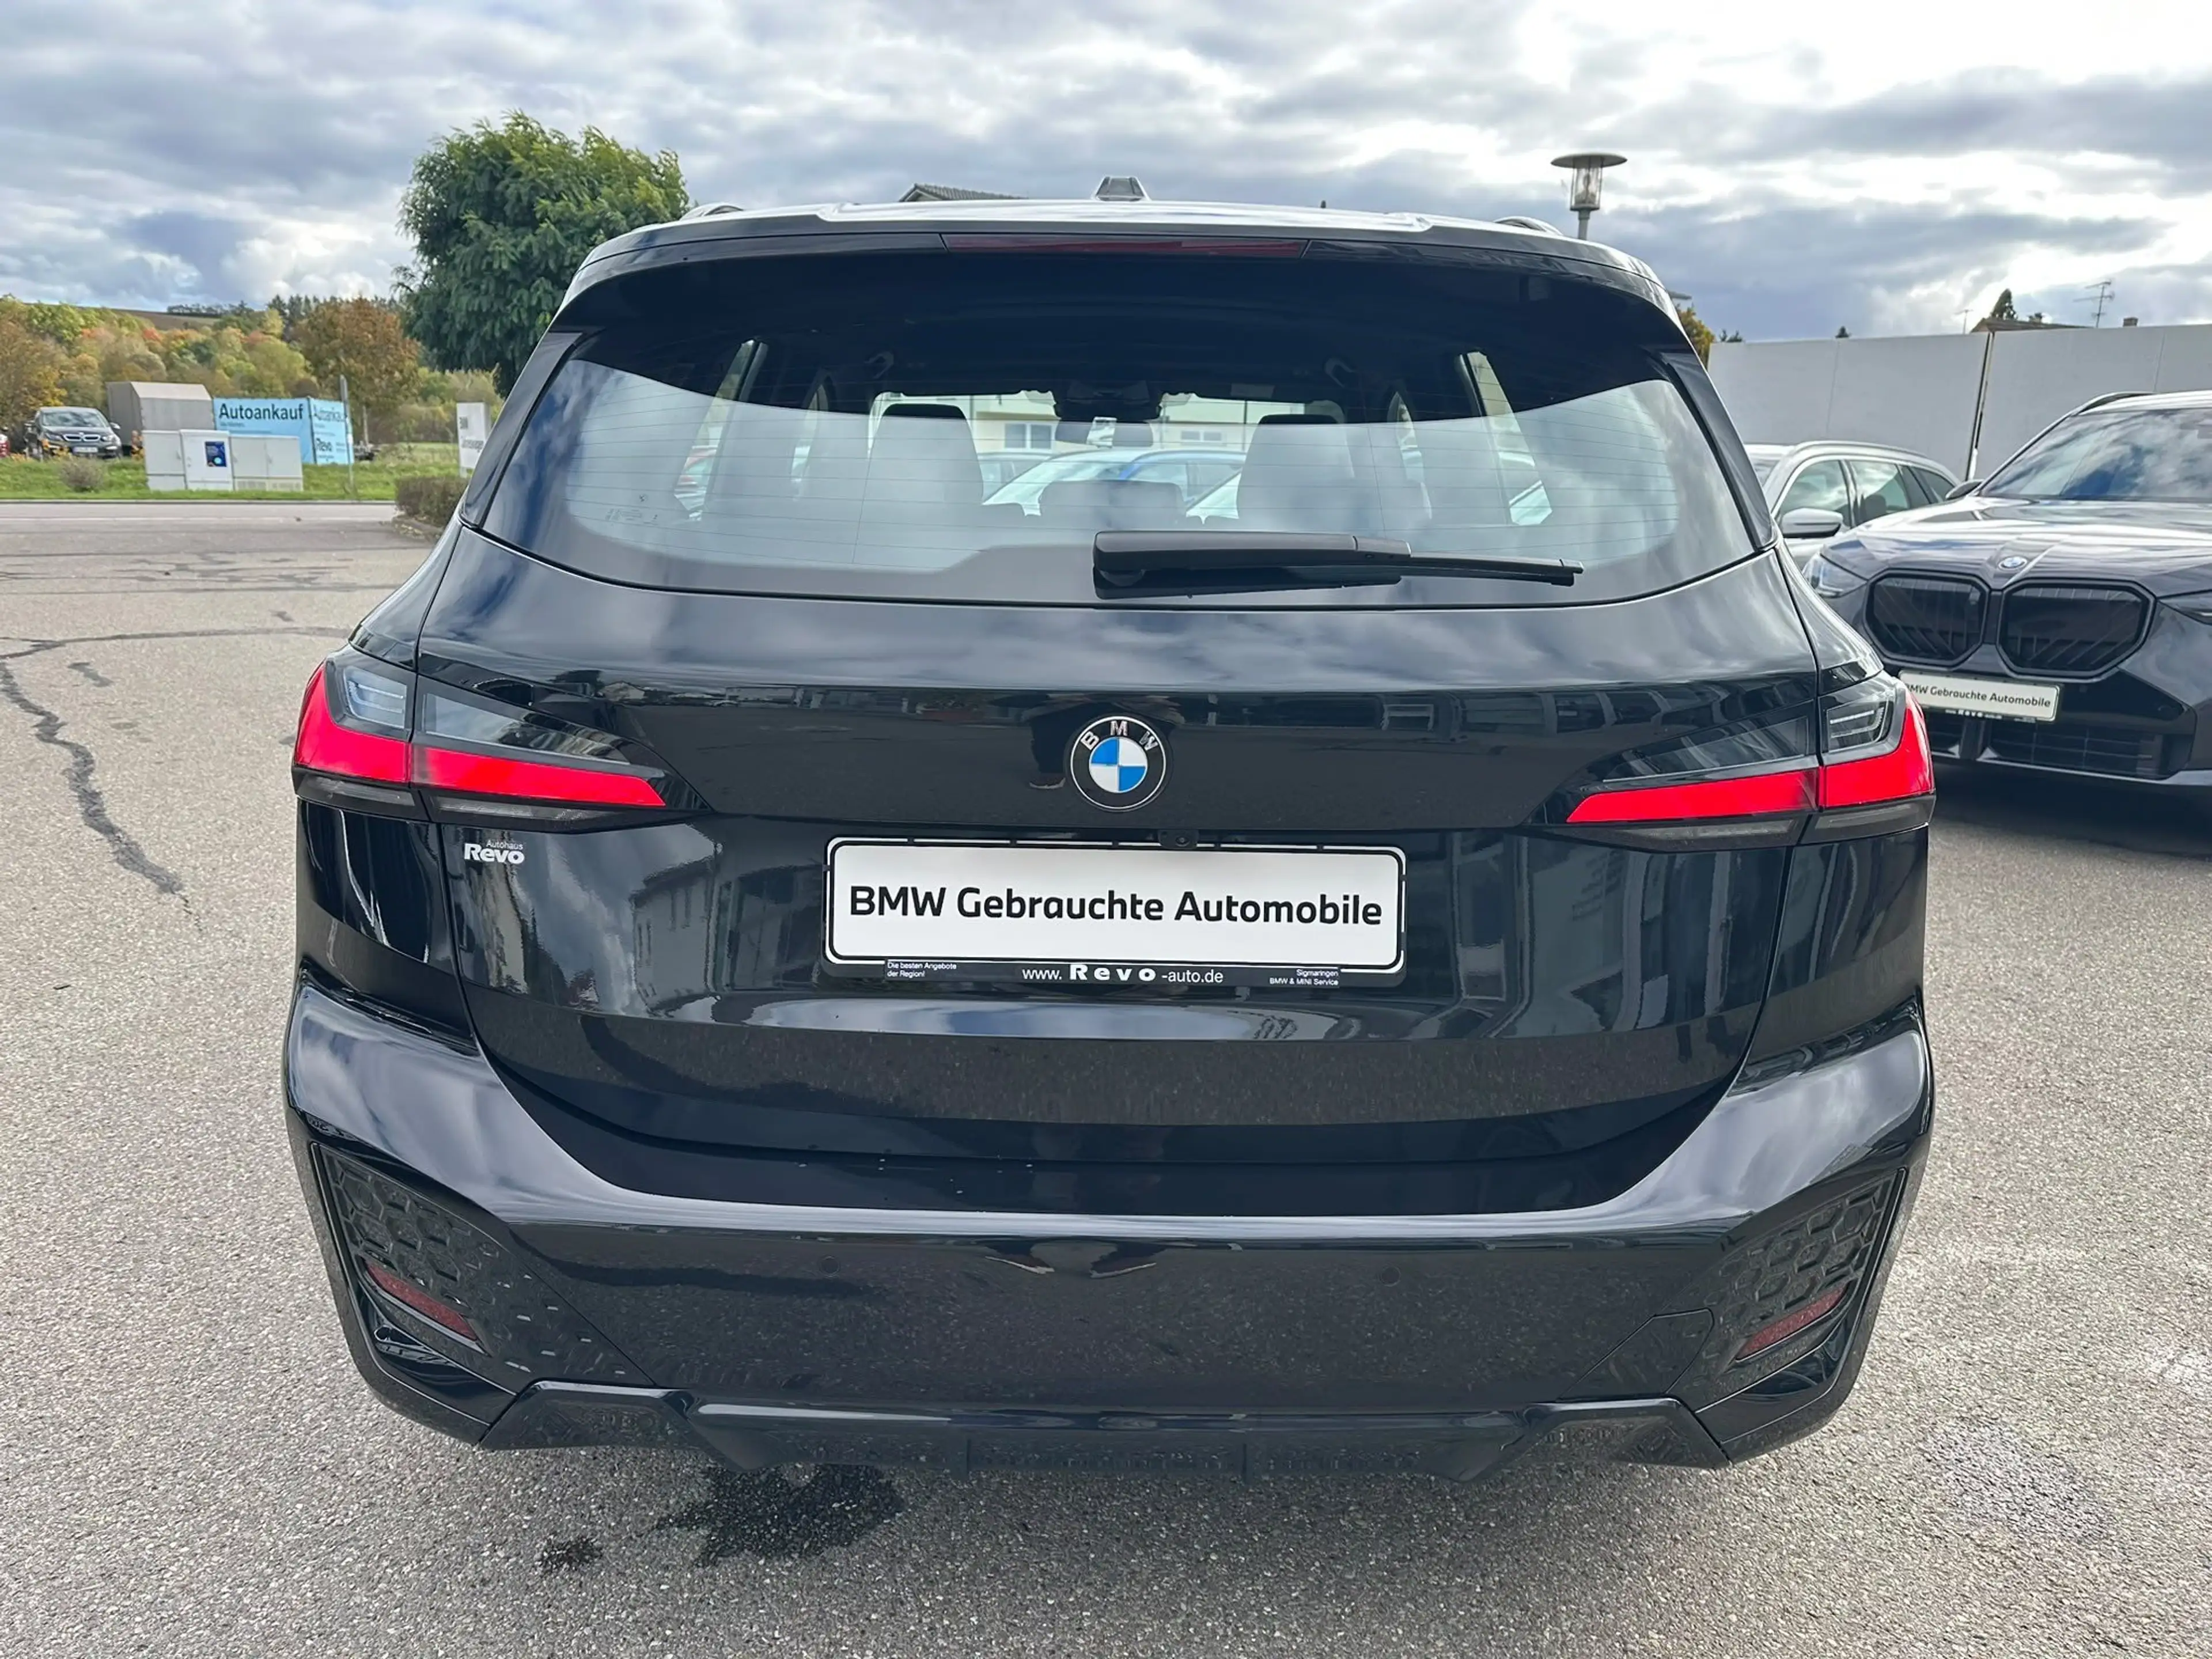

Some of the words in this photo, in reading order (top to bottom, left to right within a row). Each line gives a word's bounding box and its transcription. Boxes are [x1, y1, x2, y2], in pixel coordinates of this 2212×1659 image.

[219, 403, 304, 420] Autoankauf
[1930, 686, 1987, 701] Gebrauchte
[1989, 692, 2051, 707] Automobile
[1081, 720, 1158, 751] BMW
[464, 843, 525, 864] Revo
[486, 840, 523, 850] Autohaus
[850, 886, 946, 916] BMW
[957, 887, 1164, 921] Gebrauchte
[1175, 891, 1382, 925] Automobile
[924, 963, 957, 971] Angebote
[1296, 969, 1339, 978] Sigmaringen
